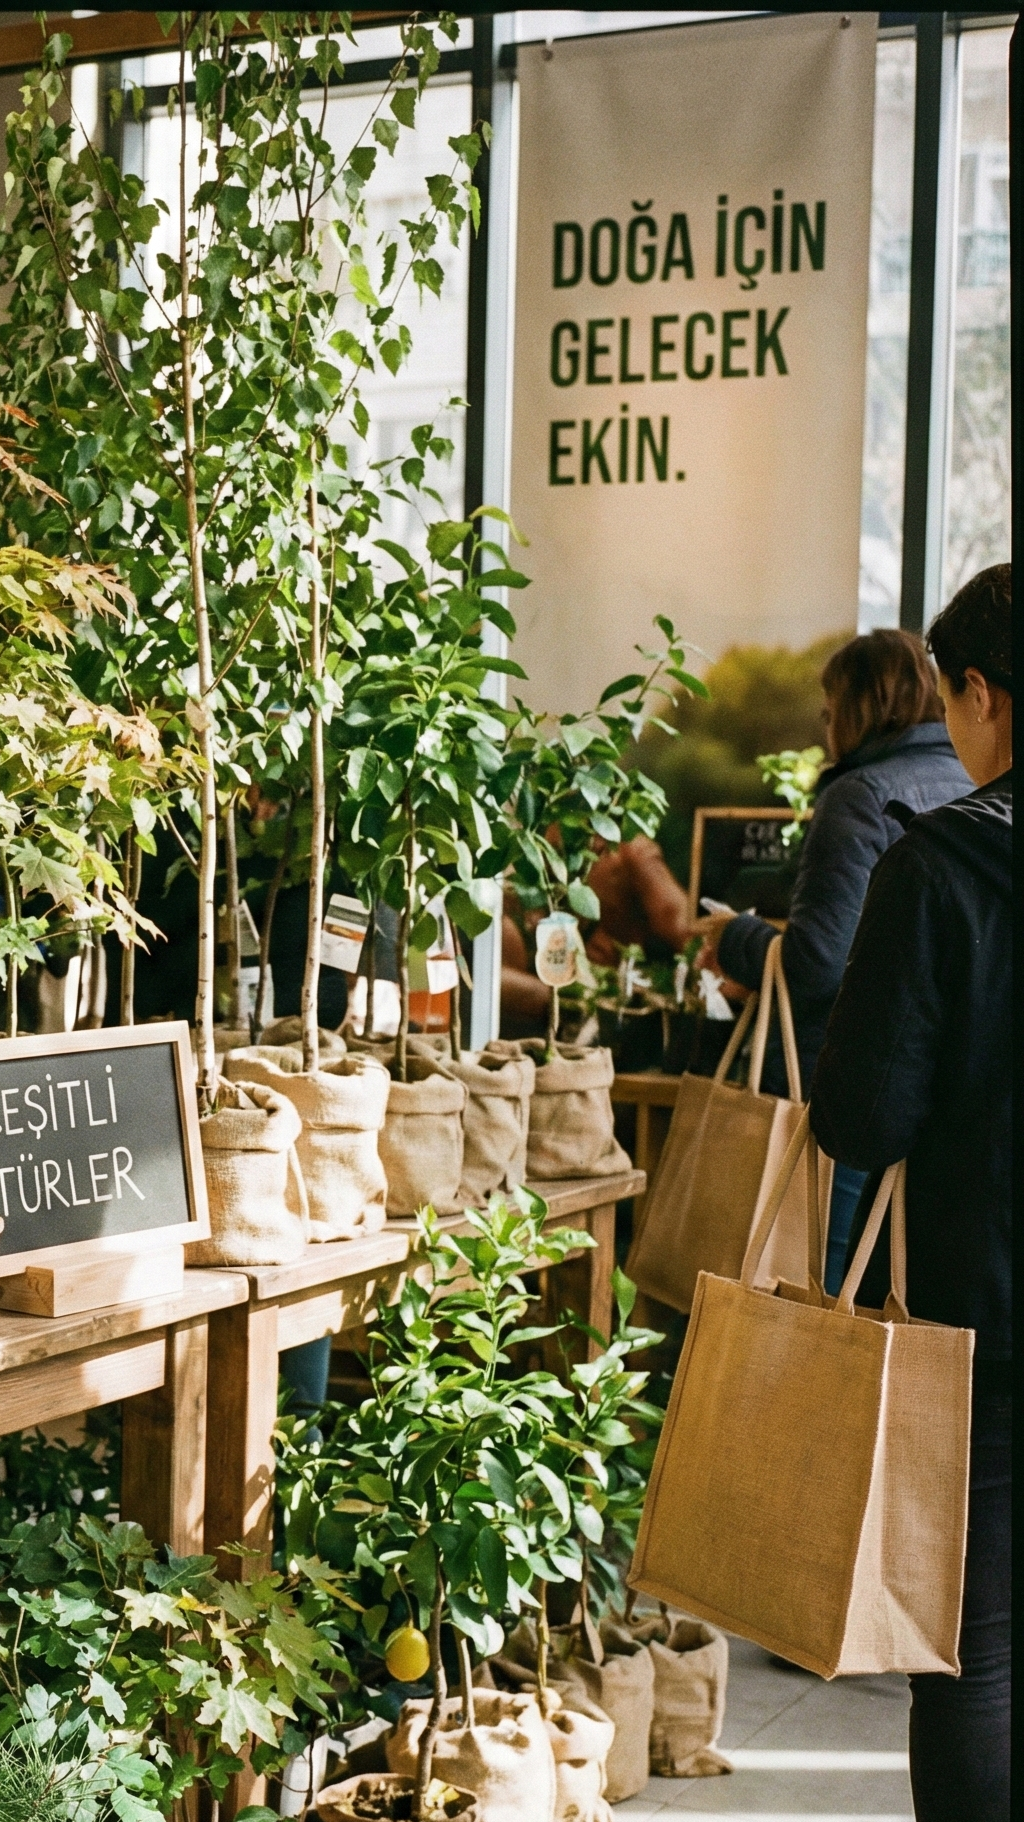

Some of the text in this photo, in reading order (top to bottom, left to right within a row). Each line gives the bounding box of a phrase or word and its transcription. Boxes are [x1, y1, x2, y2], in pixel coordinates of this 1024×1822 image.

[552, 188, 827, 291] DOĞA İÇİN
[550, 306, 791, 388] GELECEK
[547, 403, 687, 486] EKİN.
